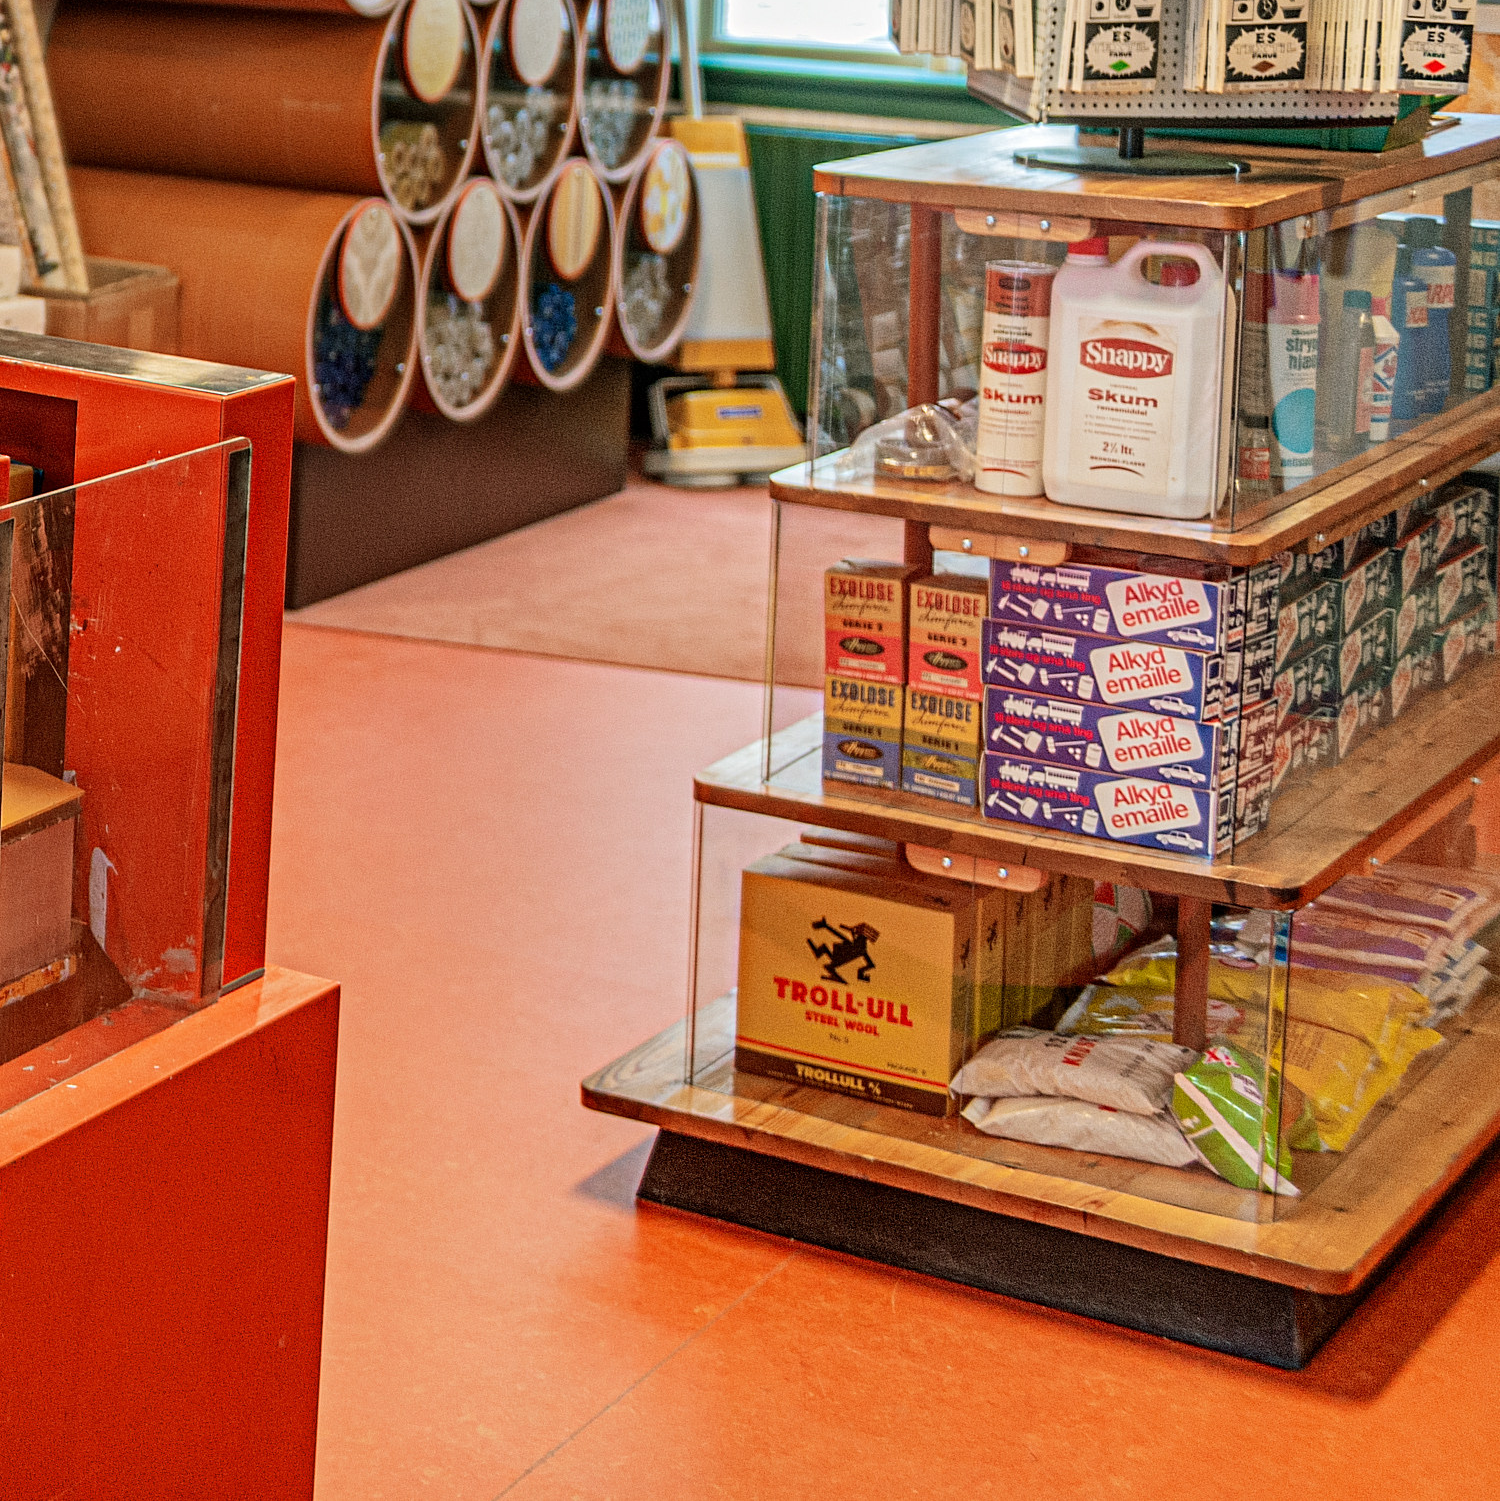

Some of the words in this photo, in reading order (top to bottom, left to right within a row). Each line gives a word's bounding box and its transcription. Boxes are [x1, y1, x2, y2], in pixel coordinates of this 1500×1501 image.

[1255, 31, 1275, 43] ES
[983, 342, 1045, 369] Snappy
[1085, 341, 1170, 374] Snappy
[983, 387, 1044, 405] Skum
[1088, 387, 1158, 408] Skum
[830, 577, 894, 602] EXOLOSE
[916, 589, 980, 617] EXOLOSE
[1124, 579, 1184, 606] Alkyd
[843, 620, 873, 631] SERIE
[1122, 597, 1201, 627] emaille
[1108, 647, 1166, 673] Alkyd
[831, 680, 895, 708] EXOLOSE
[1105, 667, 1182, 695] emaille
[1116, 716, 1175, 741] Alkyd
[1114, 735, 1192, 762] emaille
[1113, 784, 1173, 808] Alkyd
[1111, 802, 1189, 829] emaille
[773, 975, 914, 1028] TROLL-ULL
[804, 1009, 840, 1026] STEEL
[844, 1017, 880, 1037] WOOL
